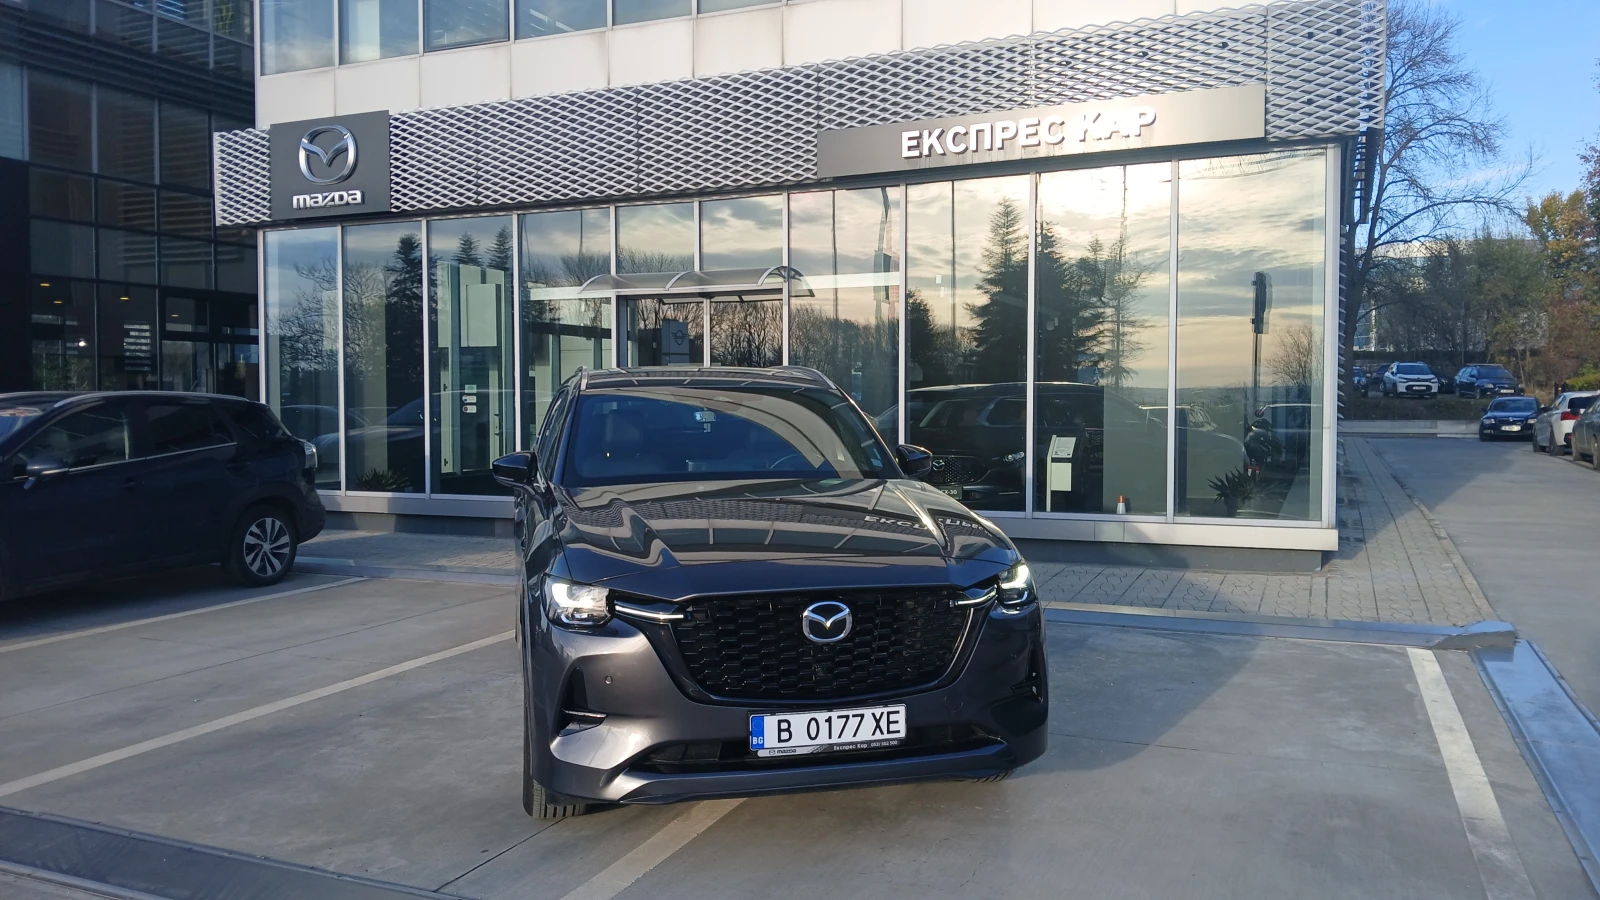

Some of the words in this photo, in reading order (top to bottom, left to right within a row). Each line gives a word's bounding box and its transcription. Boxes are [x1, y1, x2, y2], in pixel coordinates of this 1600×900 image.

[901, 115, 1065, 159] ЕКСПРЕС
[1077, 105, 1156, 142] КАР
[292, 190, 363, 209] mazda
[777, 719, 793, 744] B
[806, 713, 865, 741] 0177
[871, 710, 901, 736] XE
[752, 736, 764, 745] BG
